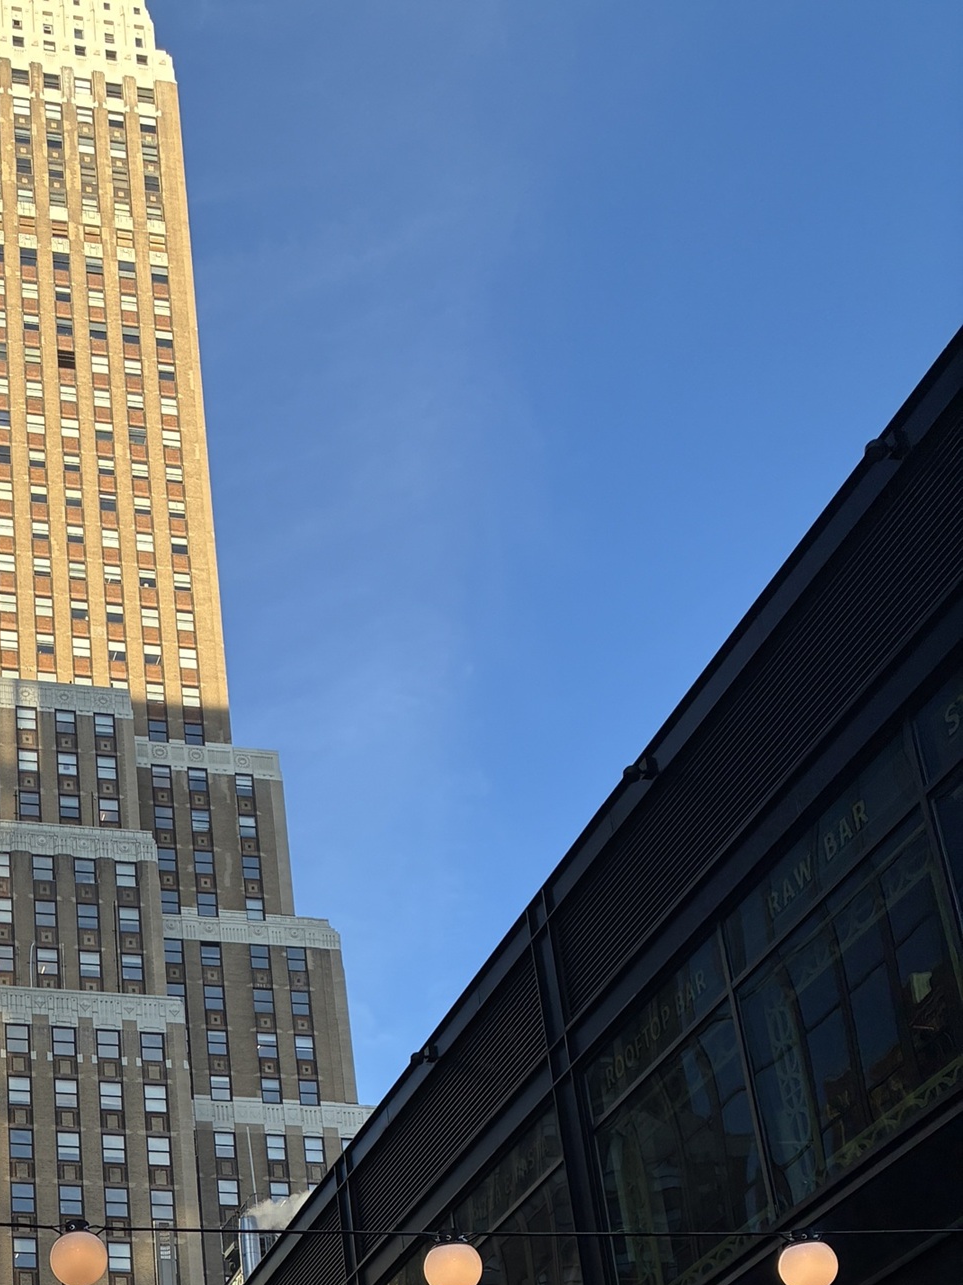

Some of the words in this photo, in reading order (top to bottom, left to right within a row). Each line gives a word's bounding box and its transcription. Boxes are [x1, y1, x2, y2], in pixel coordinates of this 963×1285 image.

[767, 854, 814, 918] RAW
[823, 800, 870, 863] BAR
[604, 1006, 672, 1086] ROOFTOP
[675, 969, 708, 1017] BAR
